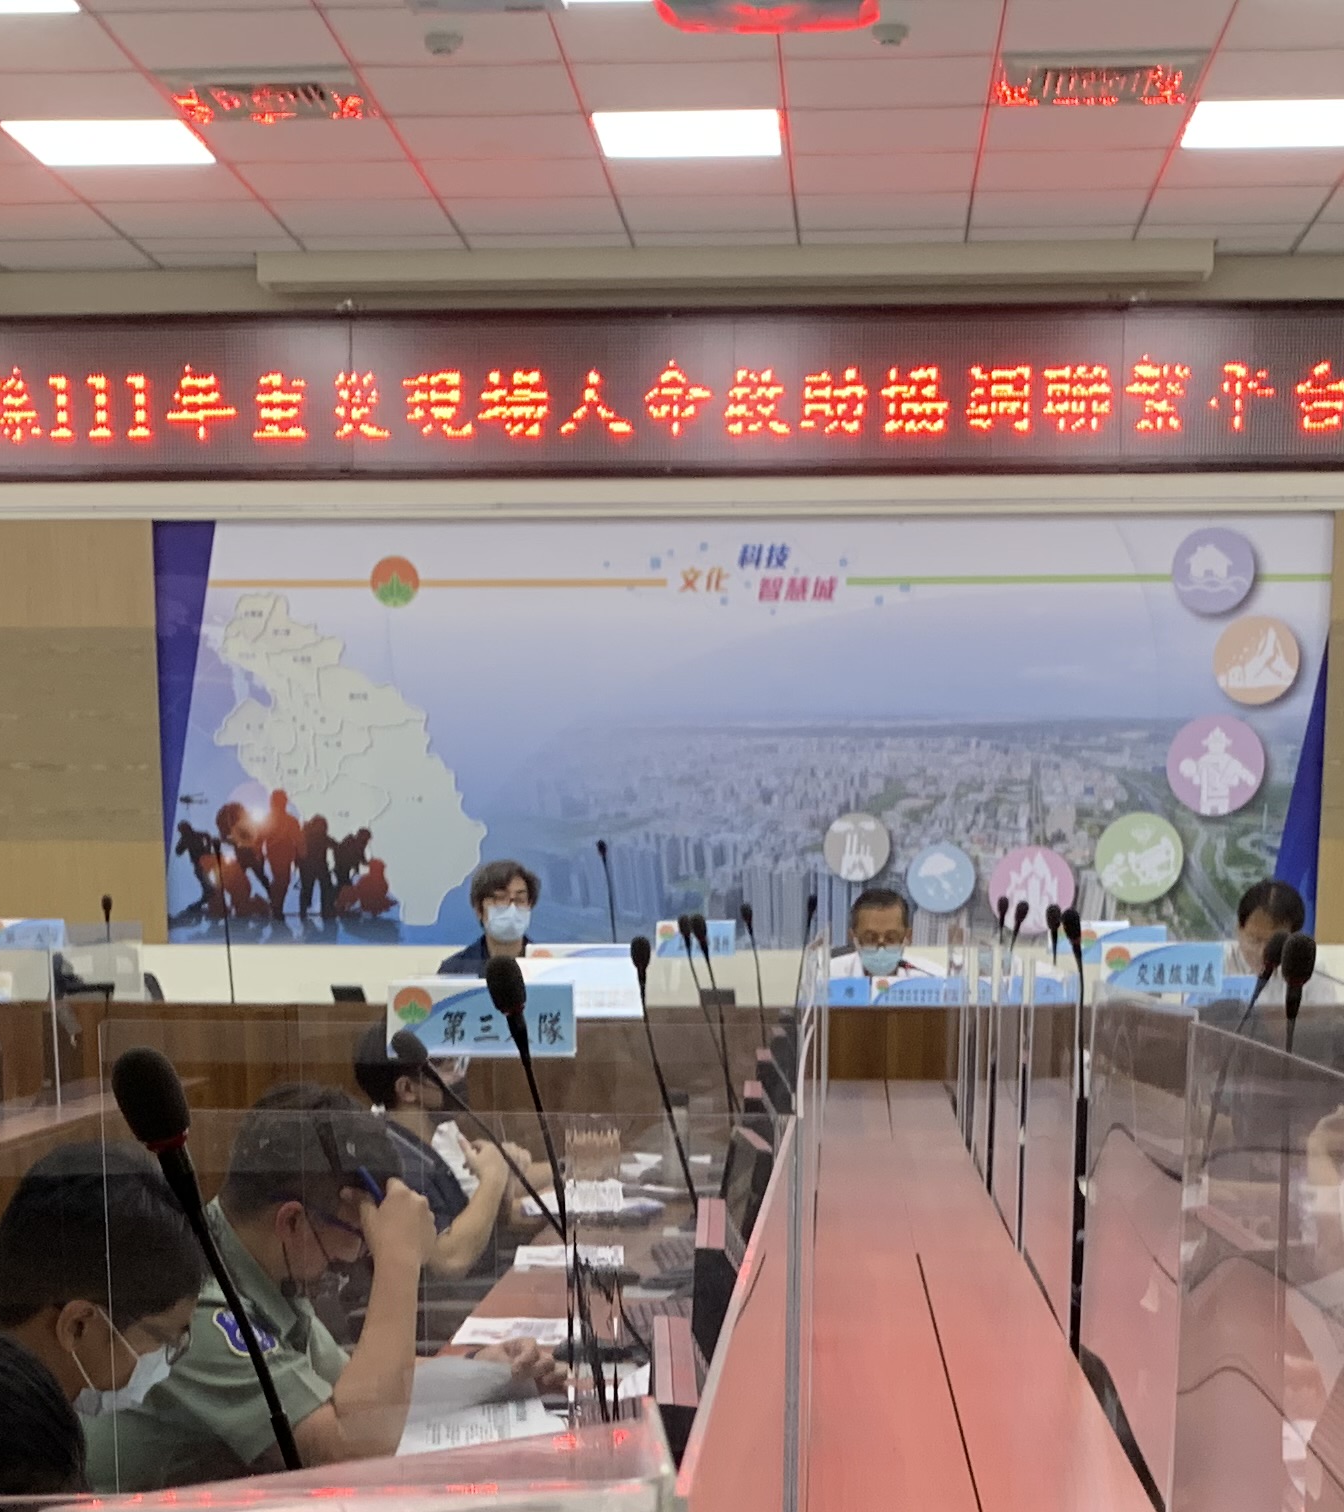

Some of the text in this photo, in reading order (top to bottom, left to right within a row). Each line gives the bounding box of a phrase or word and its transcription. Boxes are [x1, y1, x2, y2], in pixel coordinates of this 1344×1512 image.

[738, 543, 791, 570] 科技
[679, 566, 729, 593] 文化
[758, 575, 838, 602] 智慧城
[1136, 962, 1216, 987] 交通旅遊處
[441, 1009, 564, 1046] 第三隊
